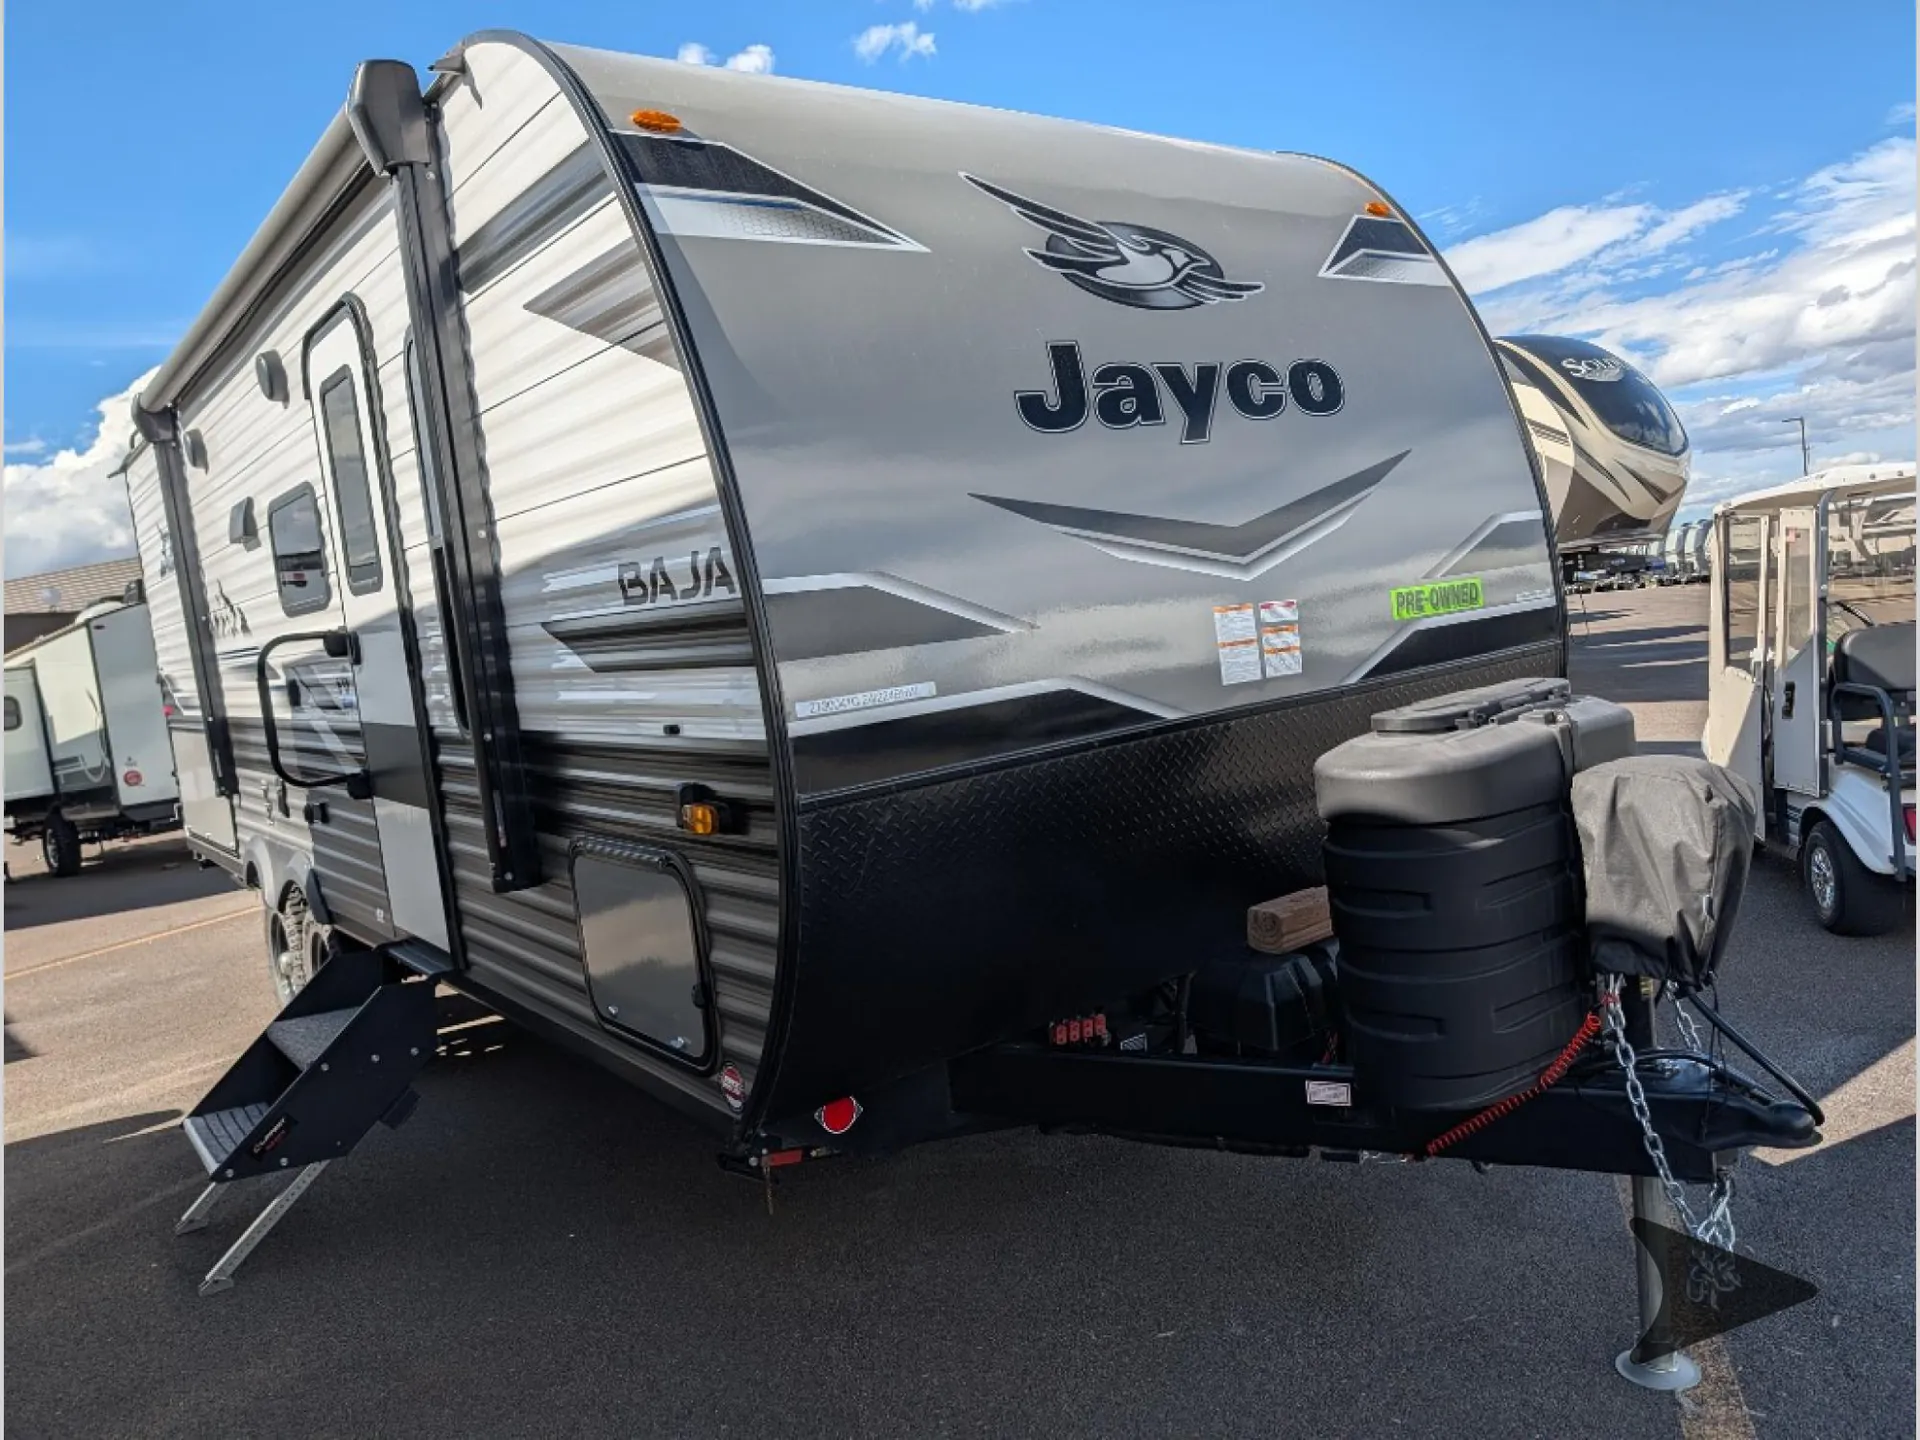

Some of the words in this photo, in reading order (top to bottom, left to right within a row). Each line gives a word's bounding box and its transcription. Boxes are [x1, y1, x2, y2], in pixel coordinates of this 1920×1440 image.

[1013, 340, 1345, 444] Jayco
[617, 547, 736, 606] BAJA
[1395, 582, 1479, 617] PRE-OWNED
